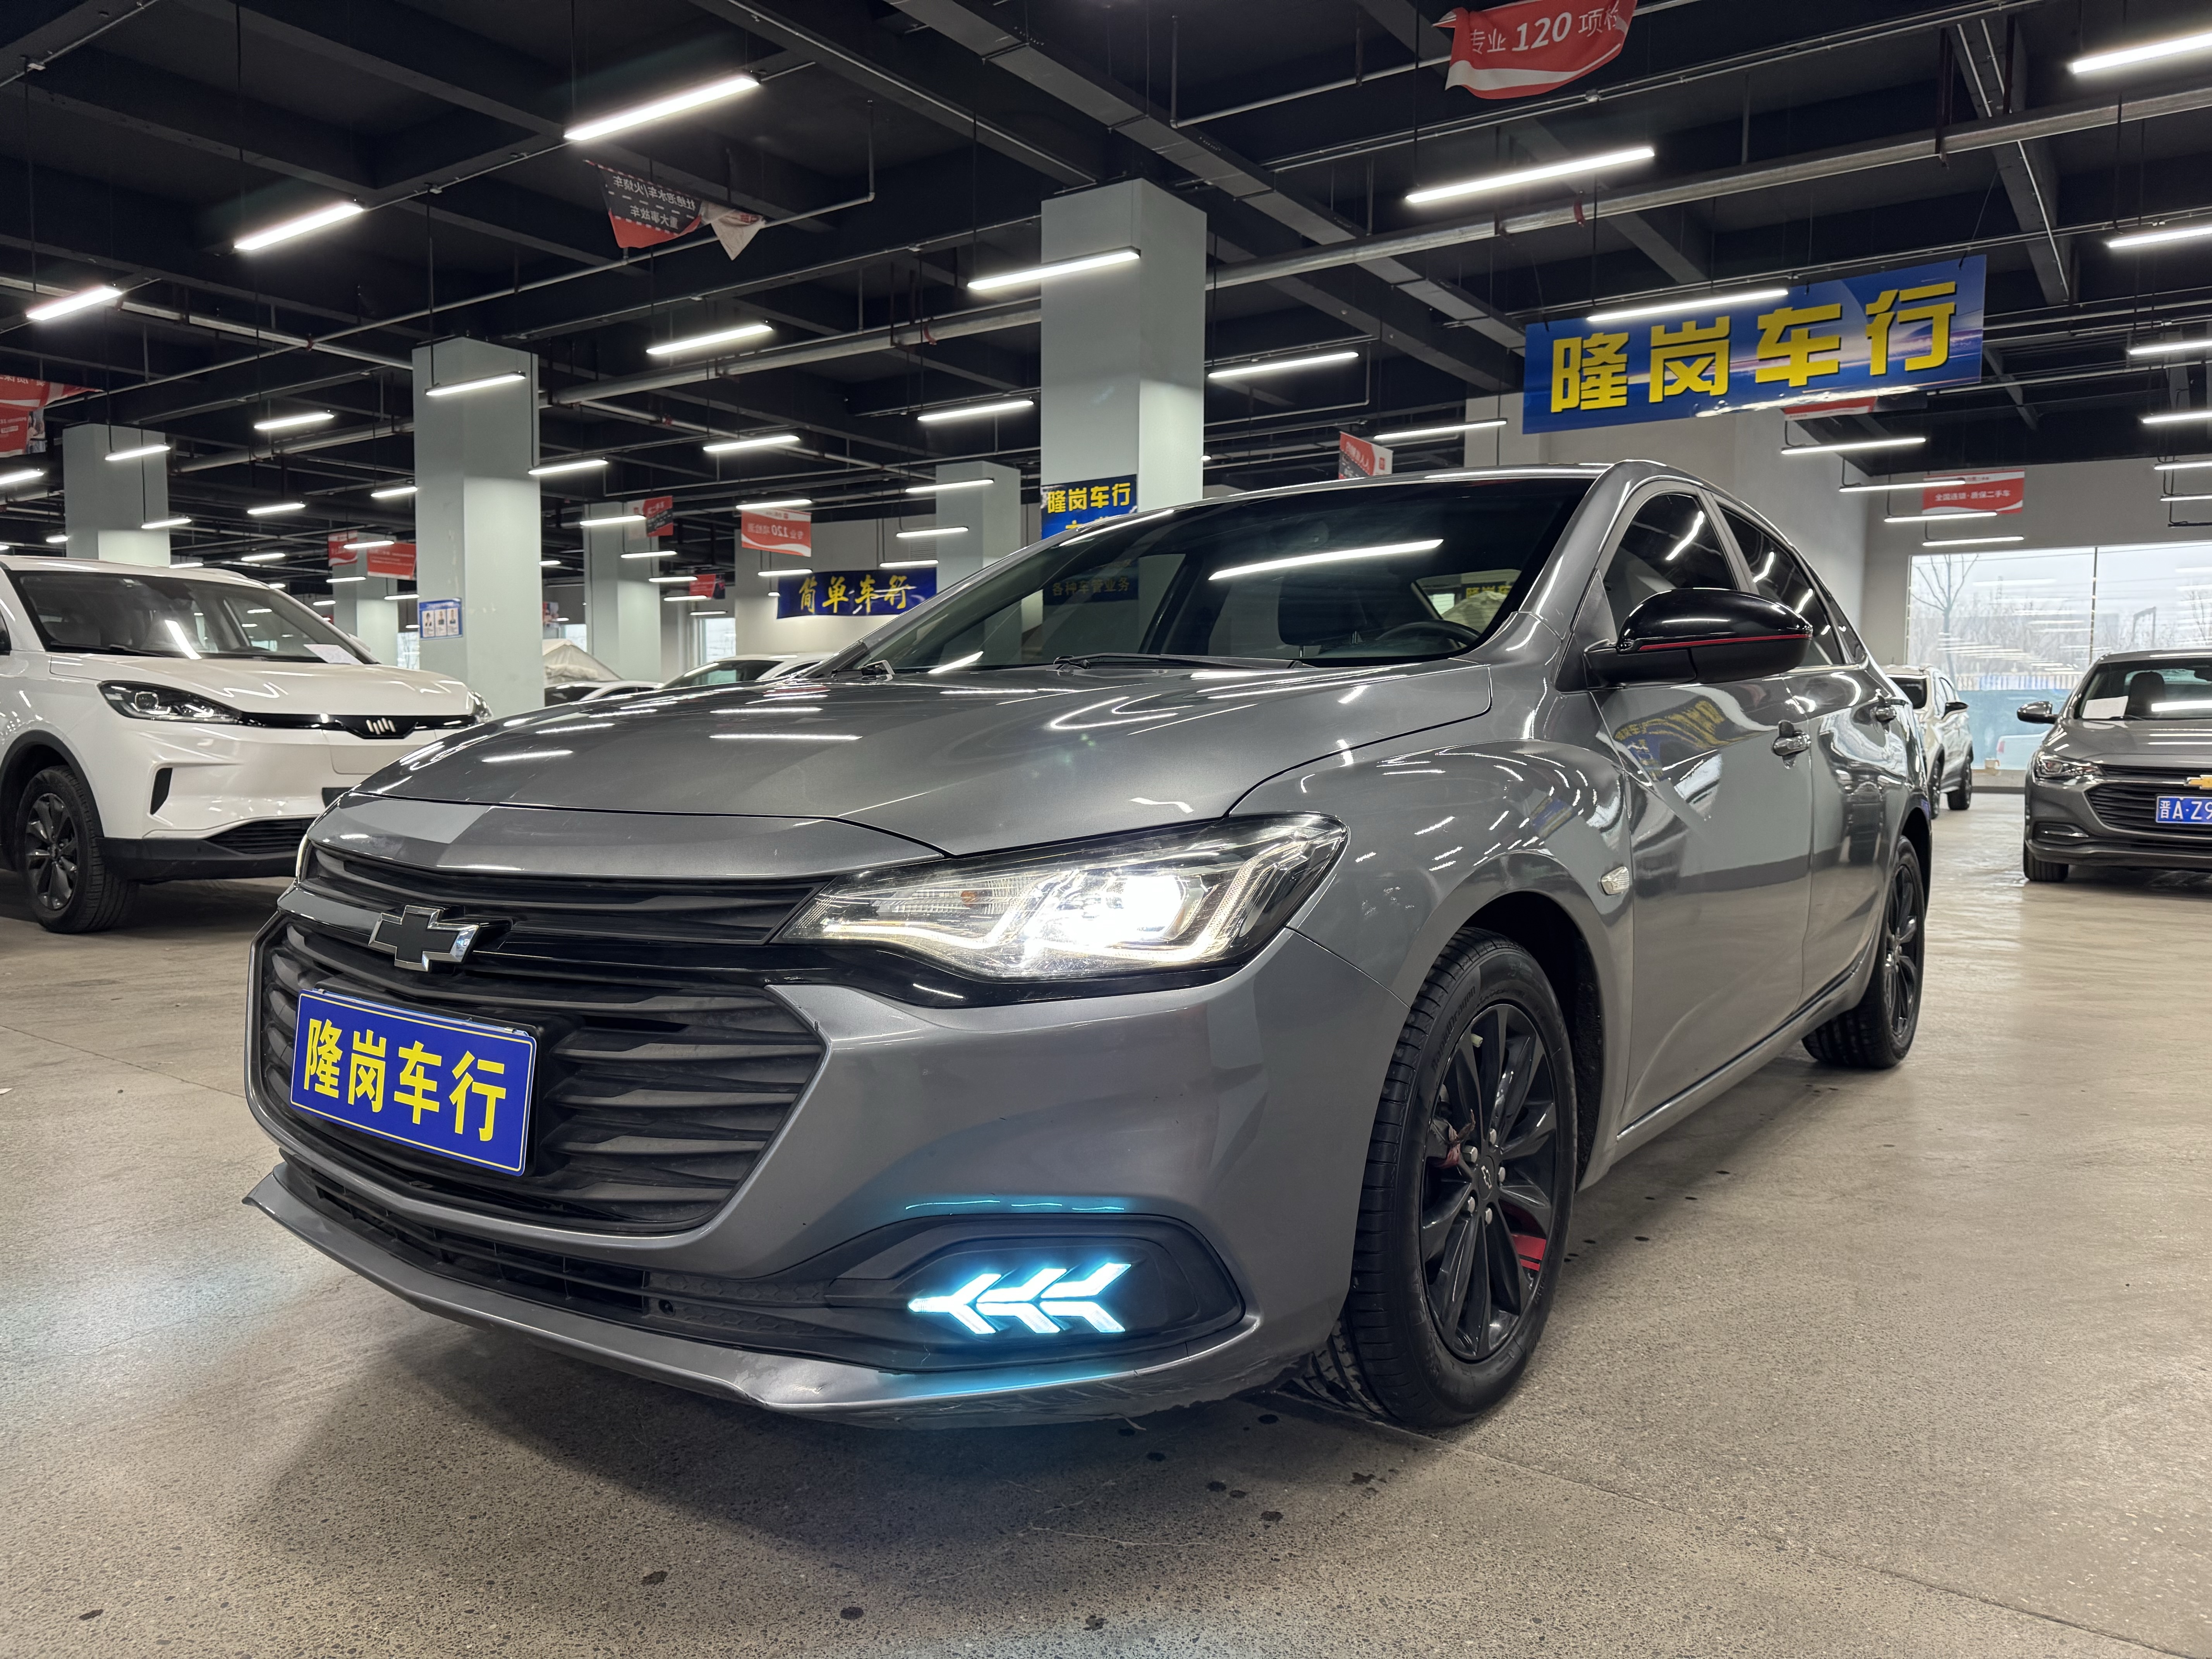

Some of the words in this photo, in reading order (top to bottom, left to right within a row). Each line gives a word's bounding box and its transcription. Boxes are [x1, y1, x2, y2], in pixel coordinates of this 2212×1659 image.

[1470, 28, 1506, 55] 专业
[1512, 12, 1572, 52] 120
[1550, 280, 1957, 413] 隆岗车行
[1048, 483, 1131, 514] 隆岗车行
[799, 574, 908, 613] 简单车行
[304, 1018, 506, 1142] 隆岗车行
